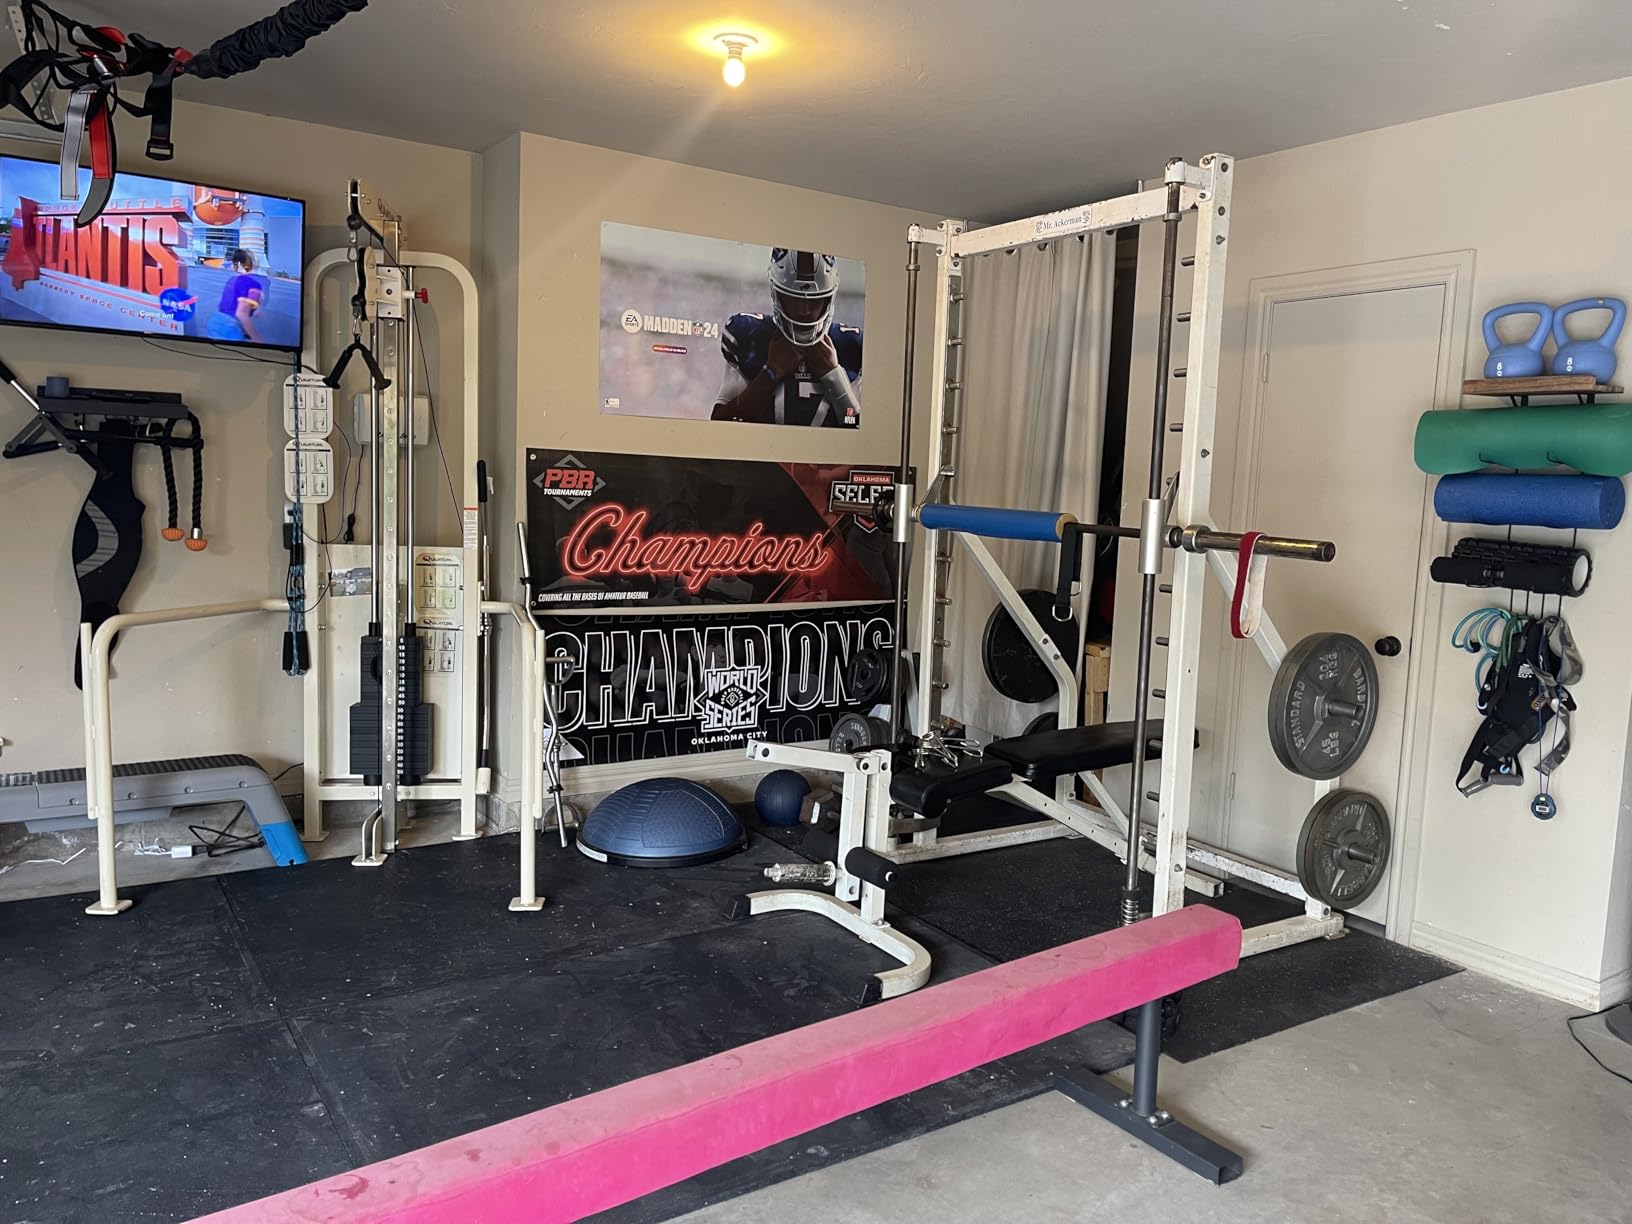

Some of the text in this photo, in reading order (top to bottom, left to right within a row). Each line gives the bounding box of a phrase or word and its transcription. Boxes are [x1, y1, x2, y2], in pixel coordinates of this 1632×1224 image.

[139, 309, 161, 319] Come
[626, 314, 638, 323] EA
[643, 315, 692, 336] MADDEN
[703, 322, 719, 339] 24
[544, 468, 595, 490] PBR
[543, 488, 593, 497] TOURNAMENTS
[834, 485, 895, 504] SELE
[564, 504, 829, 590] Champions
[538, 591, 649, 602] COVERING ALL THE BASES OF AMATEUR BASEBALL
[707, 669, 758, 698] WORLD
[1351, 667, 1367, 728] BARBL
[704, 694, 757, 729] SERIES
[1289, 680, 1306, 750] STANDARD
[691, 731, 768, 745] OKLAHOMA CITY
[1321, 737, 1331, 754] 45
[1329, 730, 1340, 758] LBS
